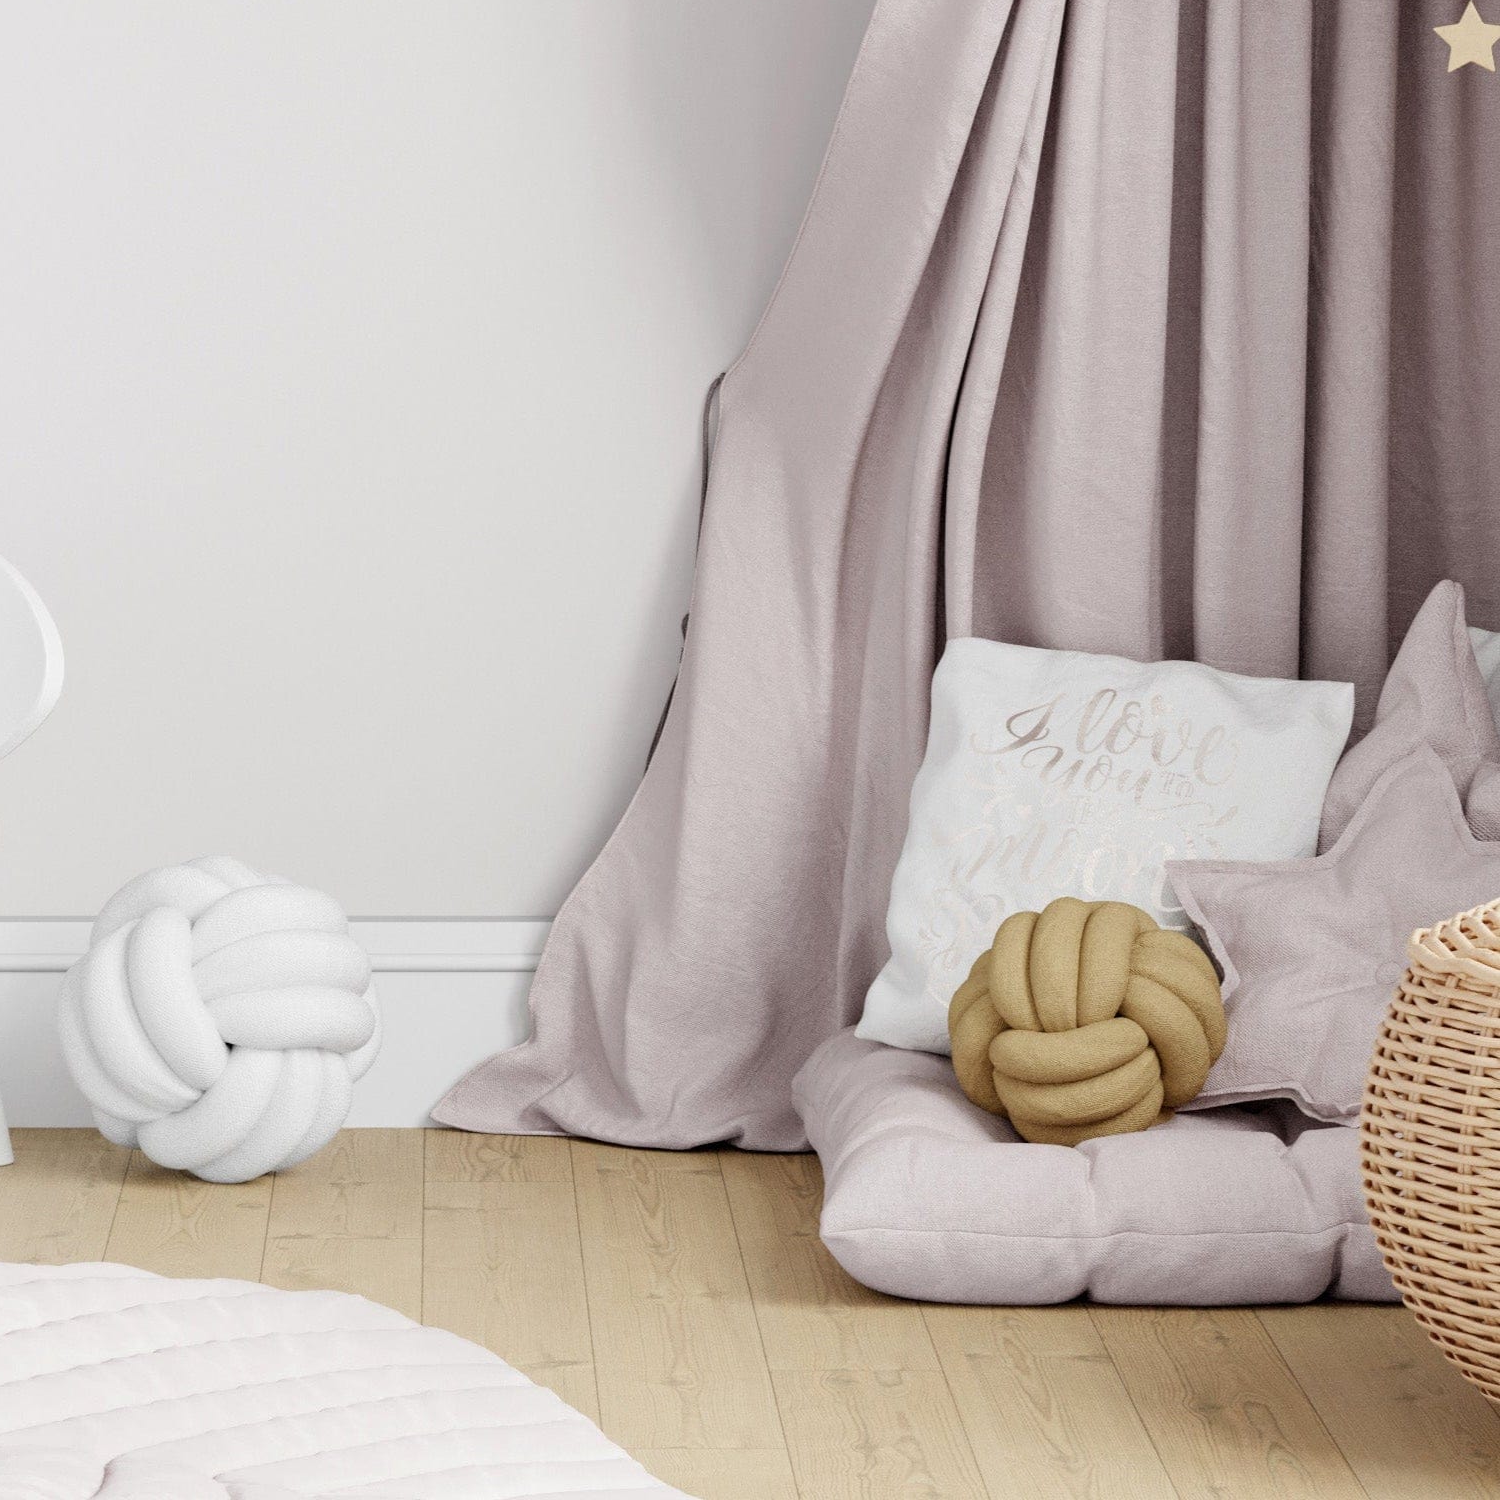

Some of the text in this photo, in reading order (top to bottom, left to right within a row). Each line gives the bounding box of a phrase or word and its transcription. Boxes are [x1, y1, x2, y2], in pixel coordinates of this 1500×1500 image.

[970, 687, 1241, 787] I love
[1020, 744, 1153, 805] you
